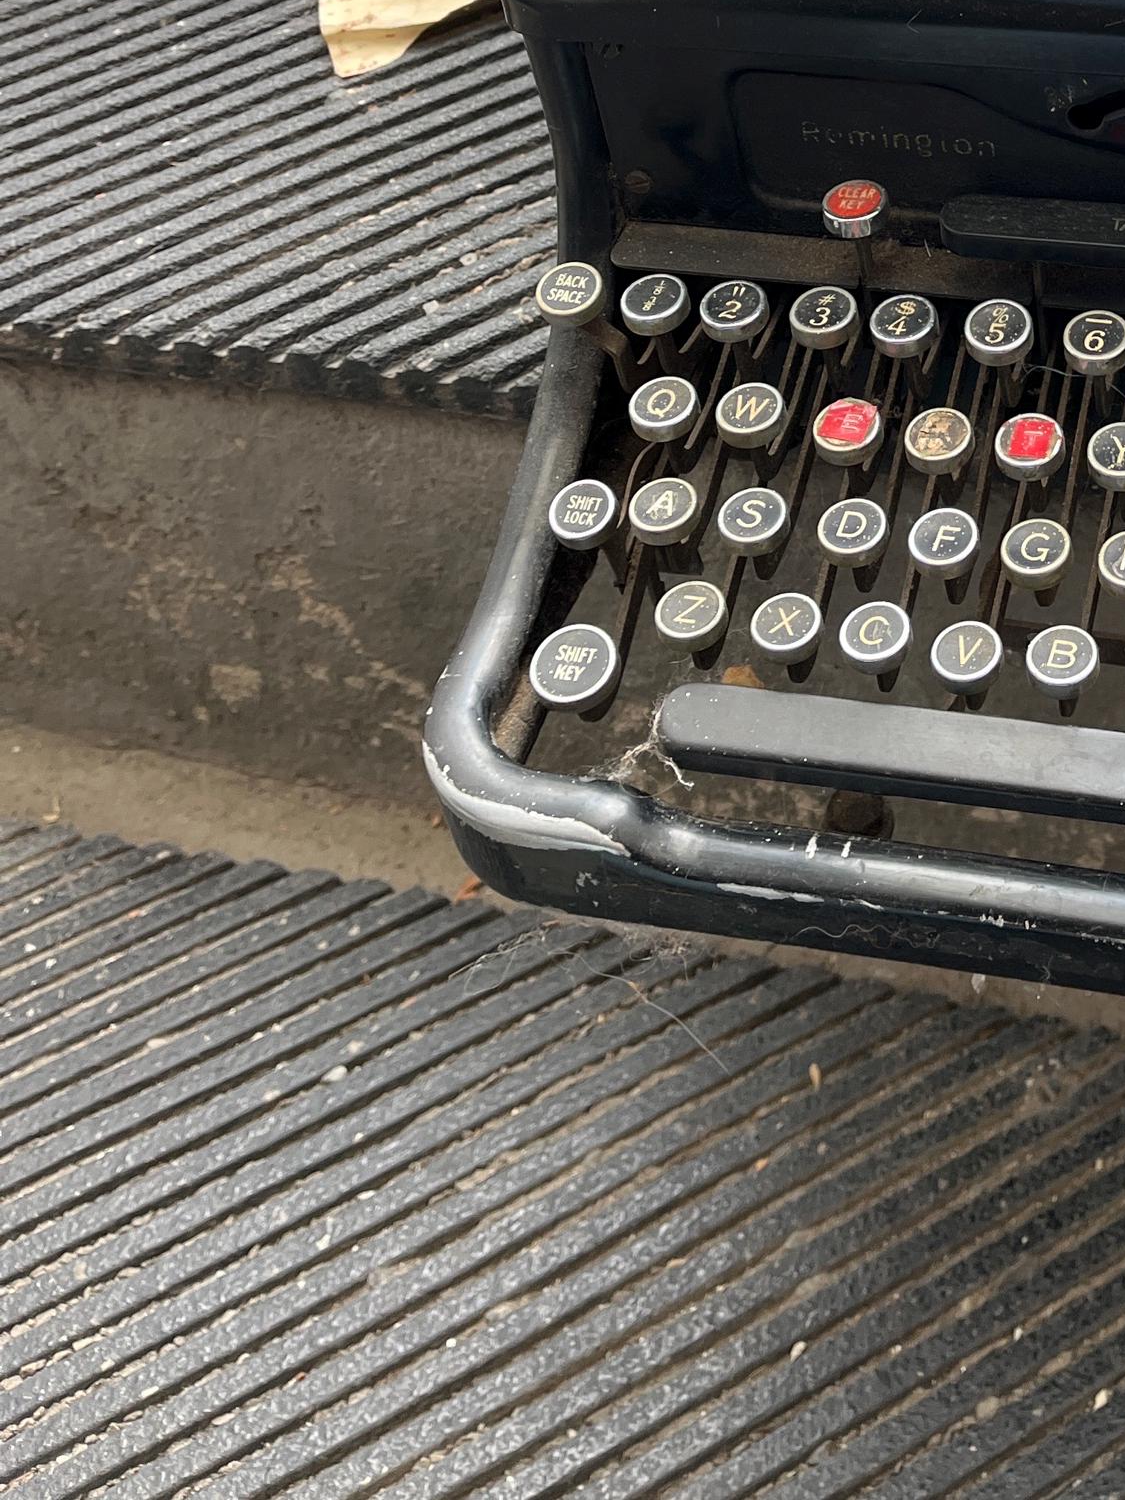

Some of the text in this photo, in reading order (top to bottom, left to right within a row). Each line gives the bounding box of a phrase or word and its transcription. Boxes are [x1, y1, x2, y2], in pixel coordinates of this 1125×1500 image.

[838, 187, 876, 199] CLEAR
[839, 199, 863, 210] KEY
[556, 274, 589, 289] BACK
[547, 288, 585, 304] SPACE
[818, 294, 836, 305] #
[718, 300, 742, 319] 2
[809, 307, 831, 326] 3
[895, 301, 916, 315] $
[992, 307, 1009, 323] %
[887, 316, 907, 335] 4
[985, 323, 1007, 343] 5
[1083, 330, 1105, 350] 6
[646, 389, 677, 417] Q
[733, 394, 771, 422] W
[841, 413, 865, 431] E
[1024, 431, 1044, 450] T
[567, 494, 604, 511] SHIFT
[649, 489, 674, 518] A
[563, 510, 596, 527] LOCK
[736, 499, 767, 528] S
[836, 511, 867, 538] D
[931, 524, 961, 552] F
[1020, 533, 1049, 562] G
[672, 595, 705, 624] Z
[769, 607, 802, 637] X
[859, 615, 887, 646] C
[554, 644, 598, 664] SHIFT
[957, 635, 983, 666] V
[1046, 640, 1078, 669] B
[553, 663, 587, 682] KEY
